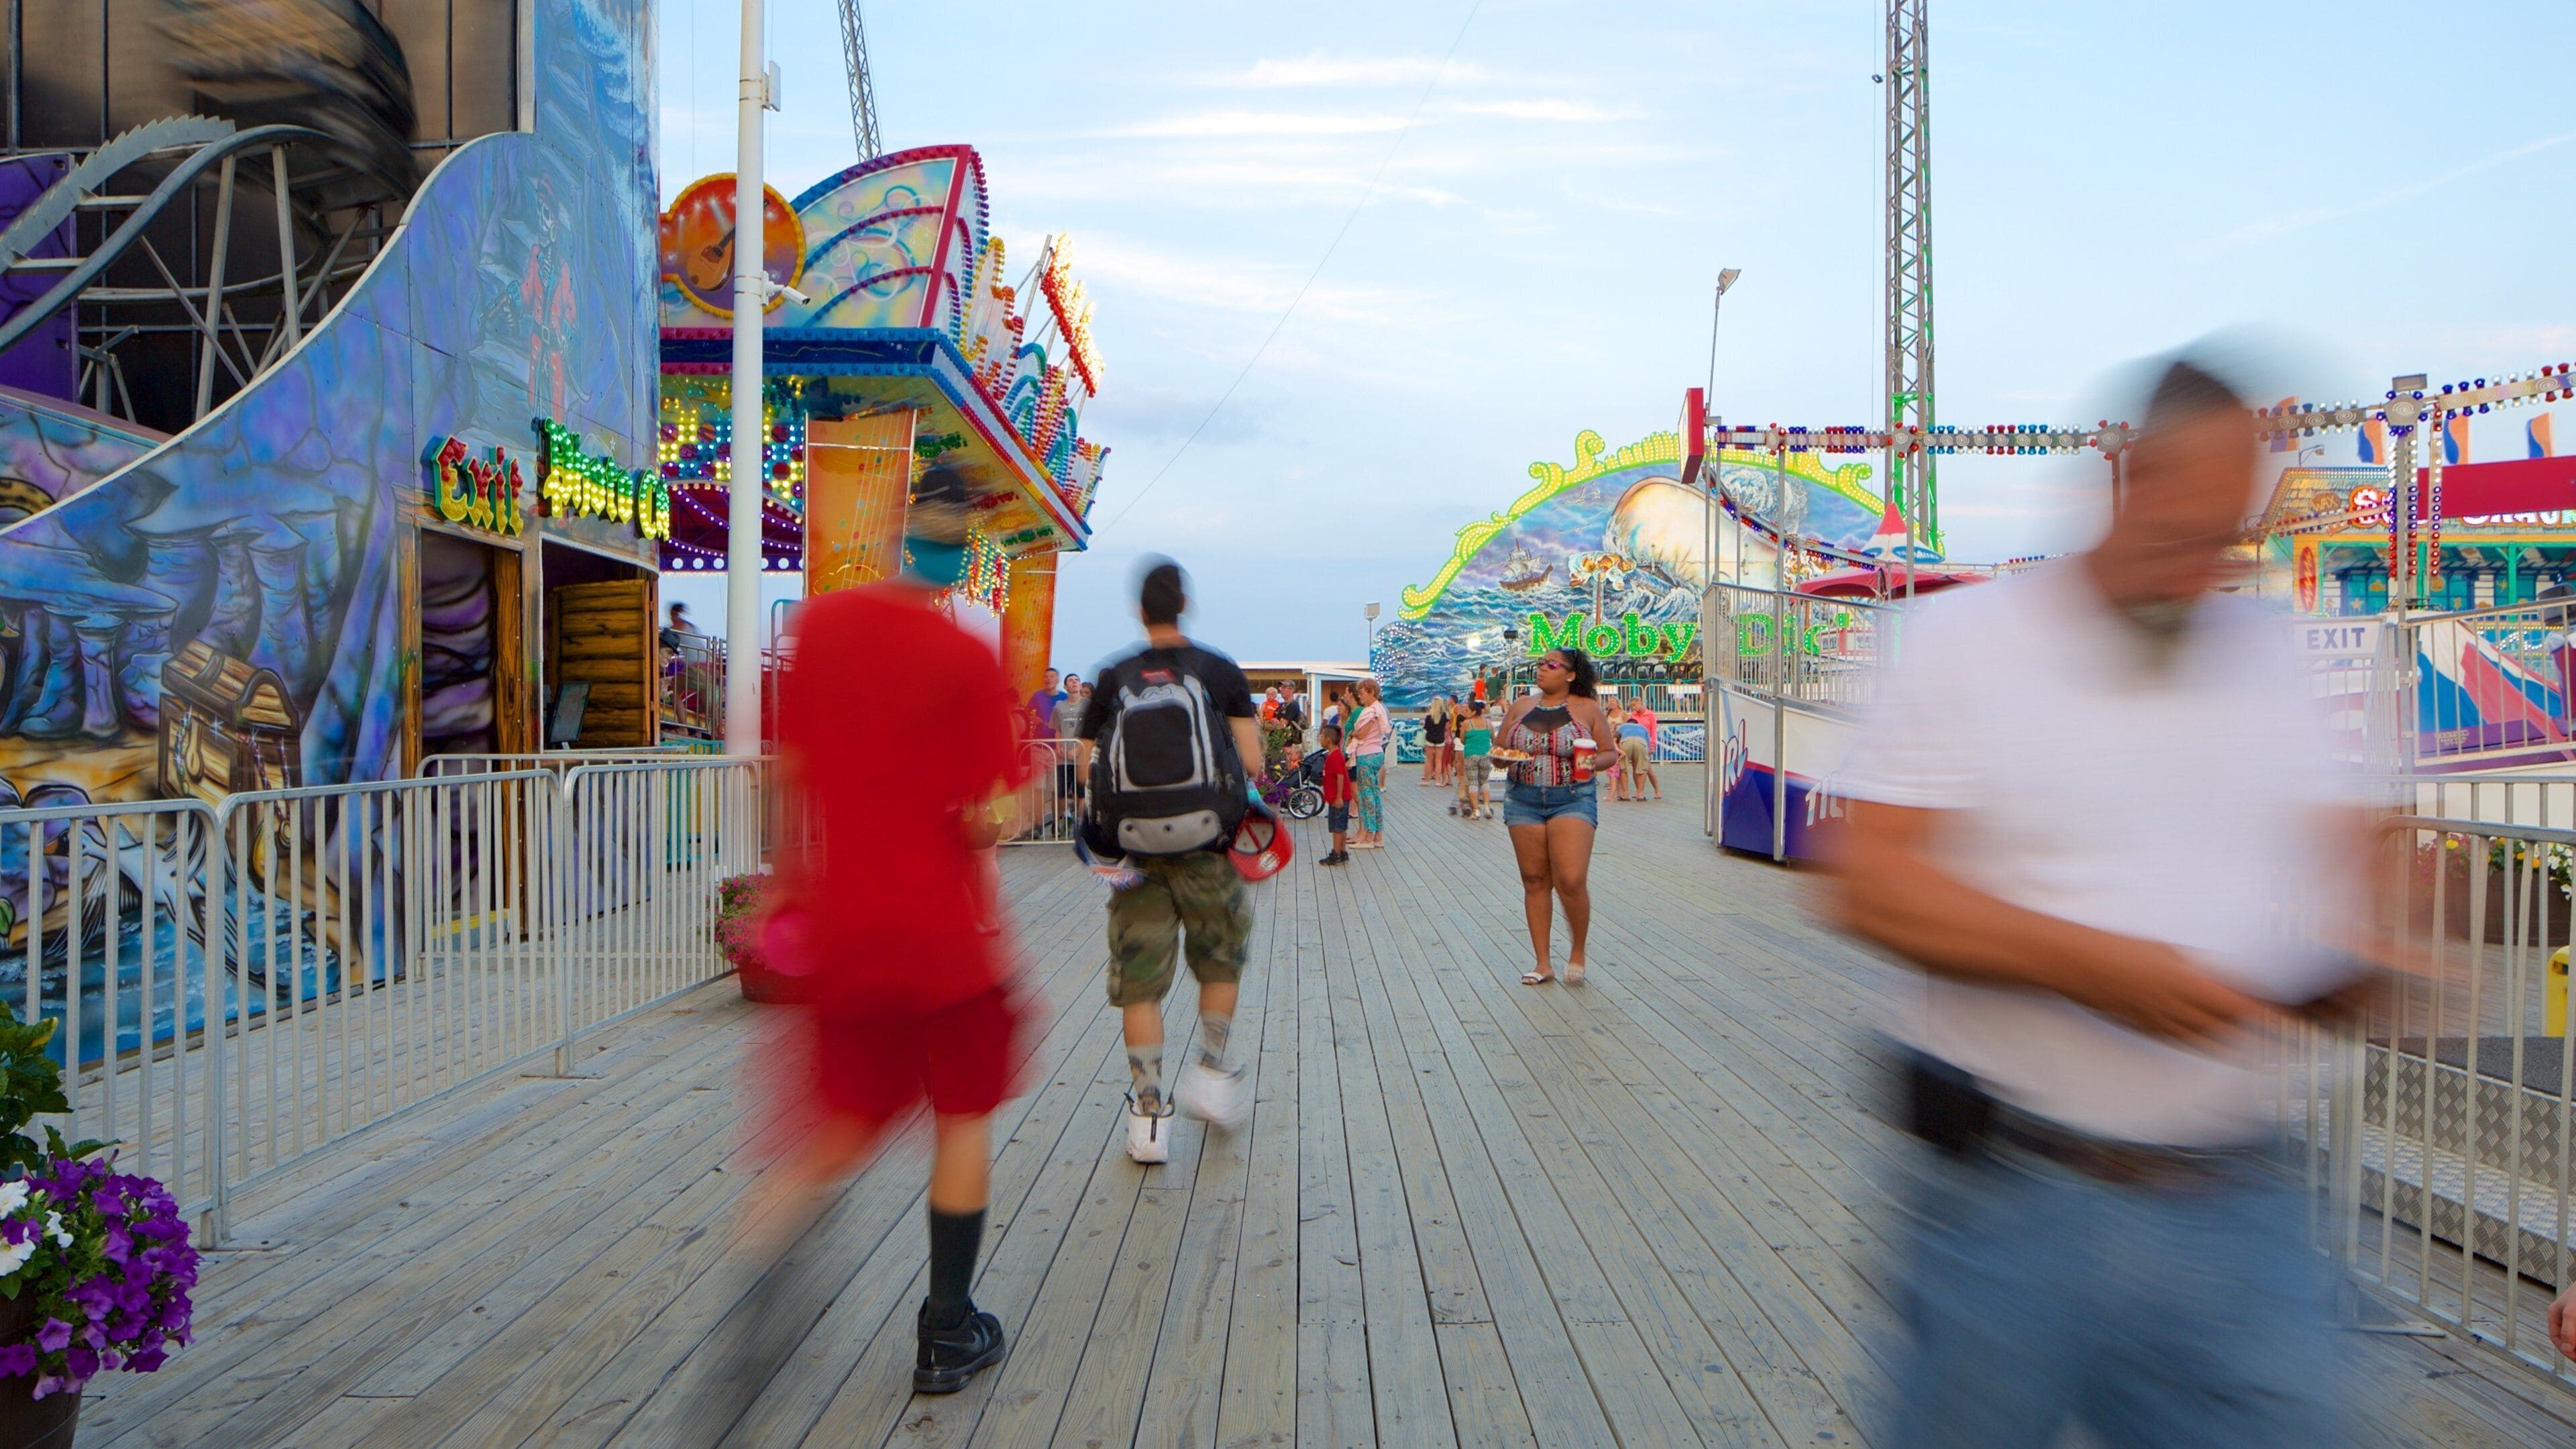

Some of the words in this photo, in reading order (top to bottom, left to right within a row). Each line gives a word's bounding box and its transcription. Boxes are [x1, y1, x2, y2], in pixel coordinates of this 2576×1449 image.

[436, 435, 524, 537] Exit
[2312, 495, 2338, 511] WAX
[1526, 612, 1698, 663] Moby
[2306, 627, 2365, 649] EXIT
